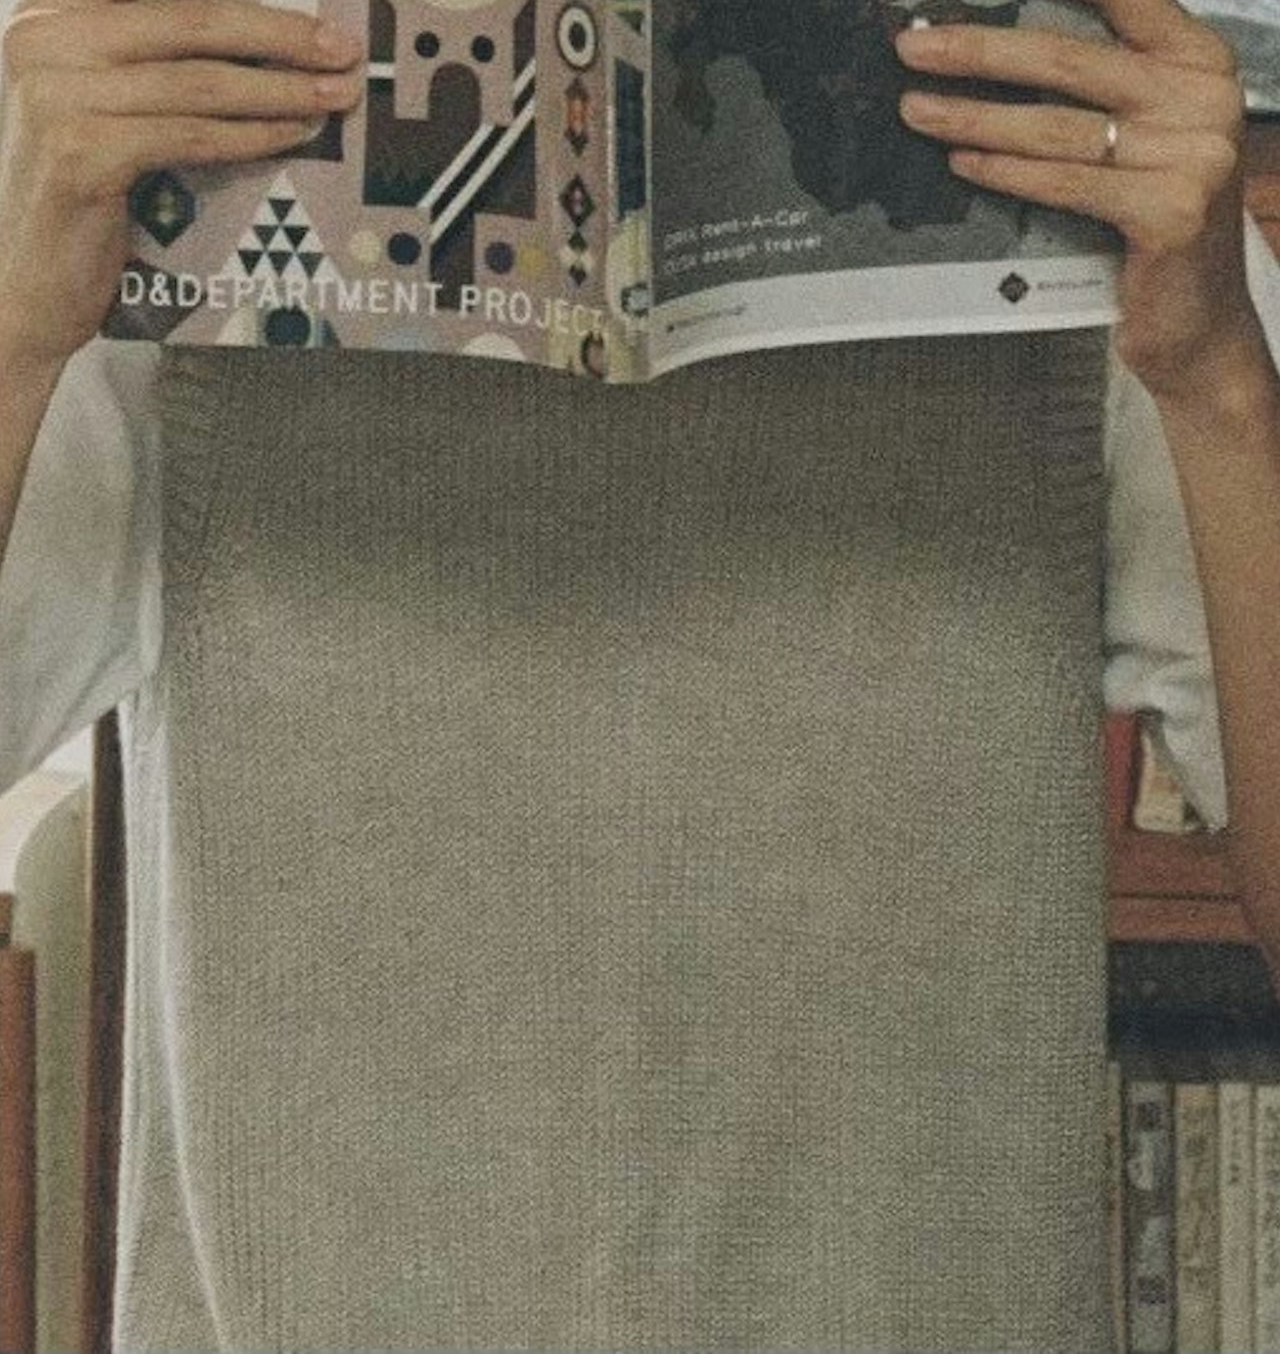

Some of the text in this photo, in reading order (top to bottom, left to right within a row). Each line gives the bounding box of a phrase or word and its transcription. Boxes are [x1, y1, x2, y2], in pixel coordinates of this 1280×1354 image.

[701, 208, 810, 238] Rent-A-Car
[119, 271, 605, 334] D&DEPARTMENT PROJECT
